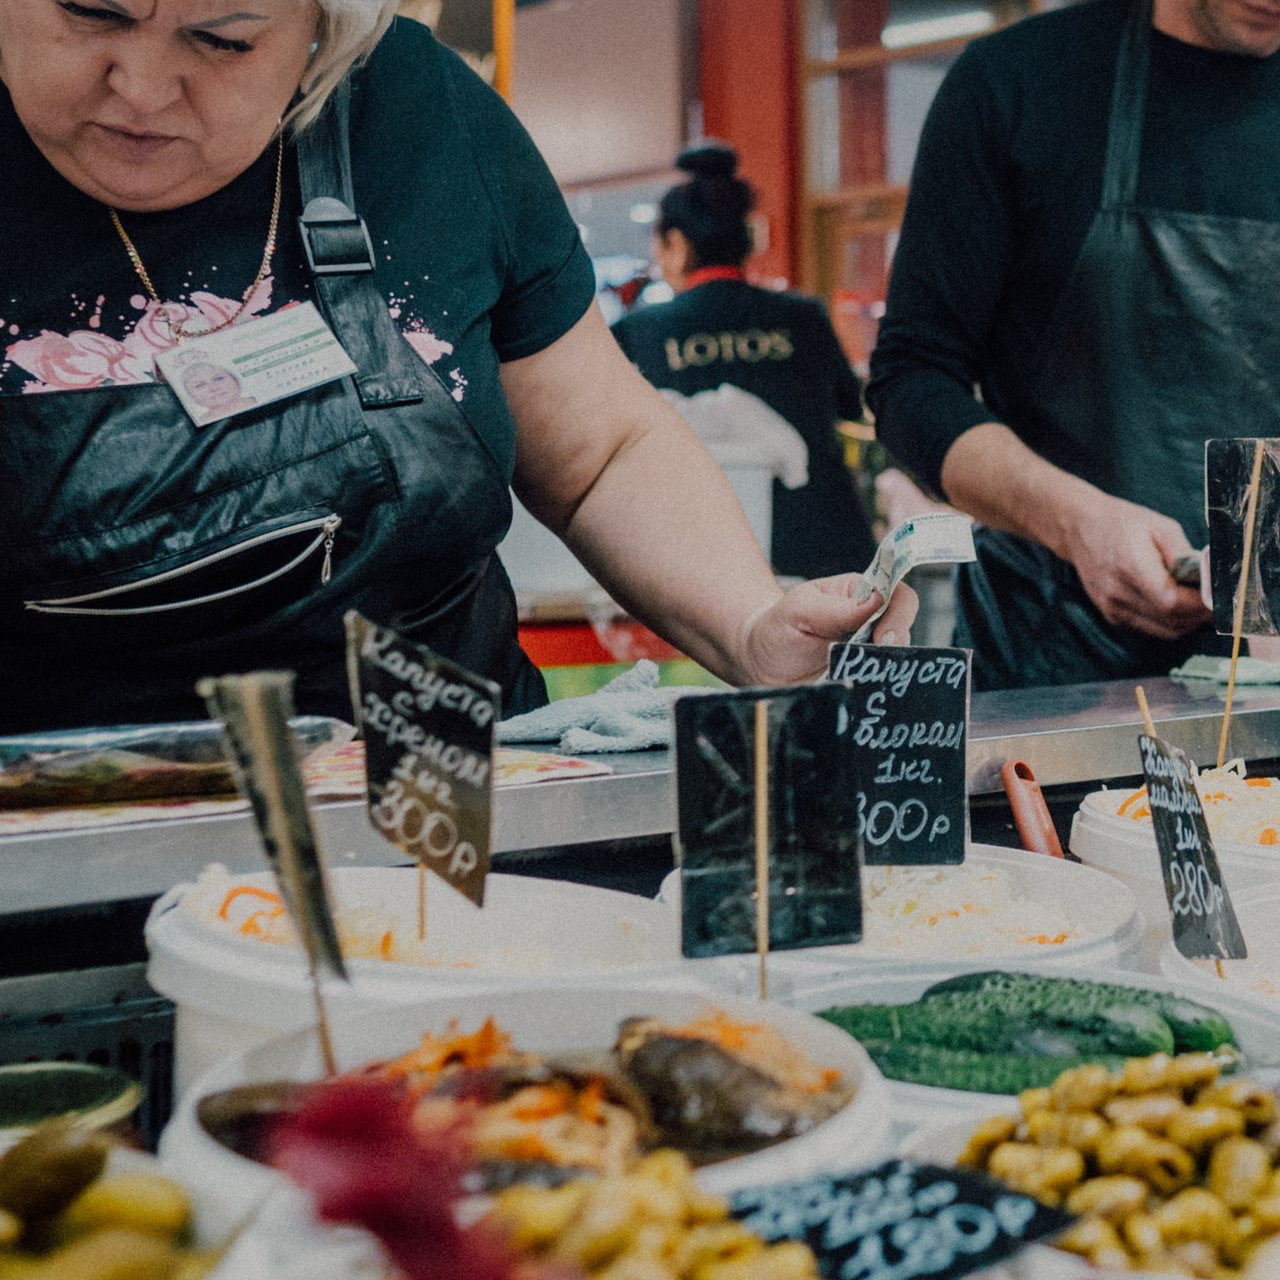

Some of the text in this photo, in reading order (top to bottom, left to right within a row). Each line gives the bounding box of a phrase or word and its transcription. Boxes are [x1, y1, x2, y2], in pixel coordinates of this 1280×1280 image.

[665, 330, 793, 370] LOTOS
[833, 646, 967, 698] Капуста
[1170, 860, 1224, 917] 280р
